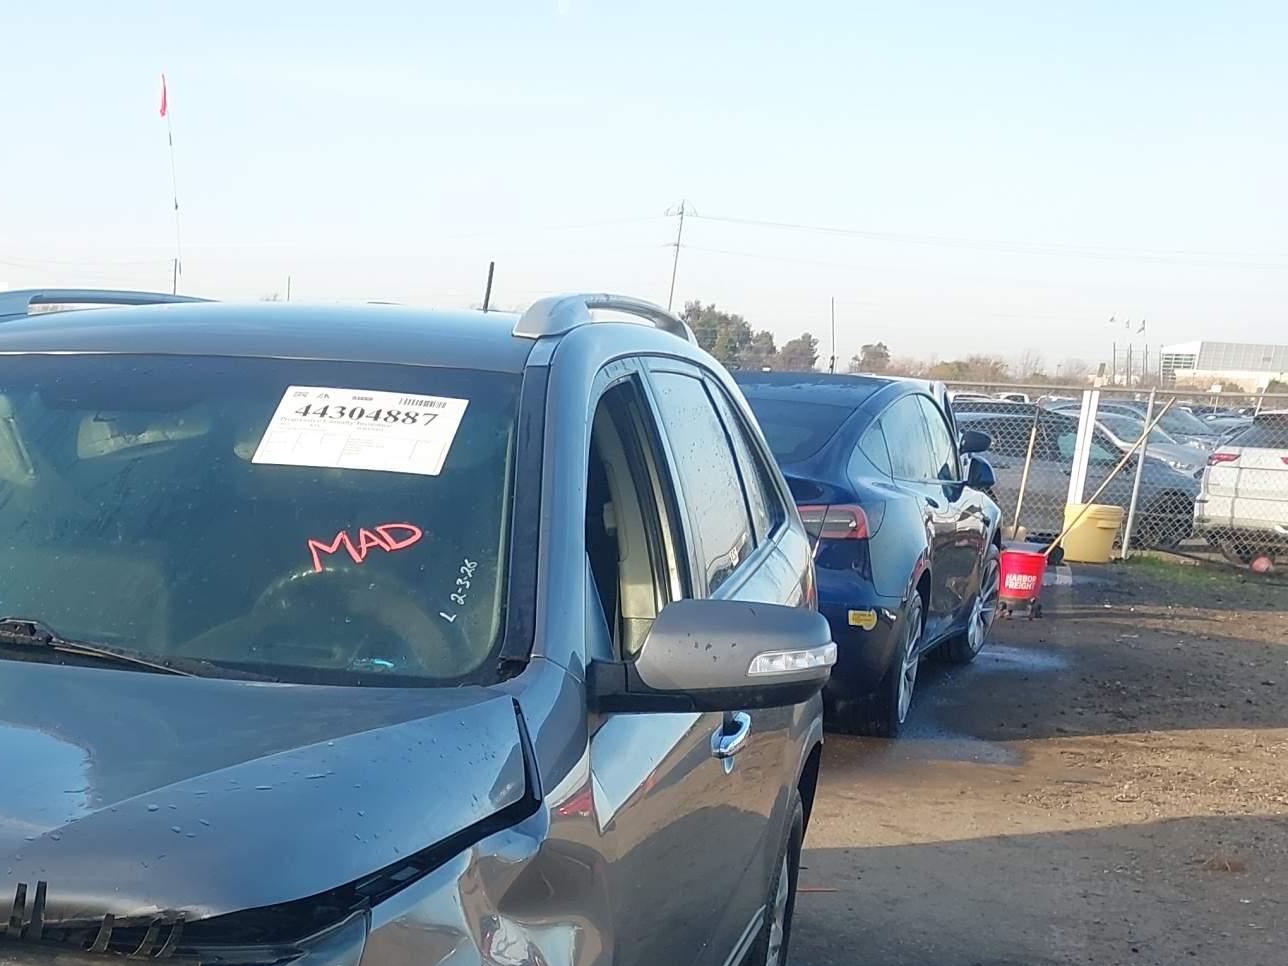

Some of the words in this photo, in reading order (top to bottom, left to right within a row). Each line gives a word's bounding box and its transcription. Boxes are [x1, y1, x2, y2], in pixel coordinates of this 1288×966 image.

[295, 404, 440, 427] 44304887
[307, 522, 423, 573] MAD
[1005, 573, 1037, 583] HARBOR
[1005, 580, 1036, 590] FREIGHT
